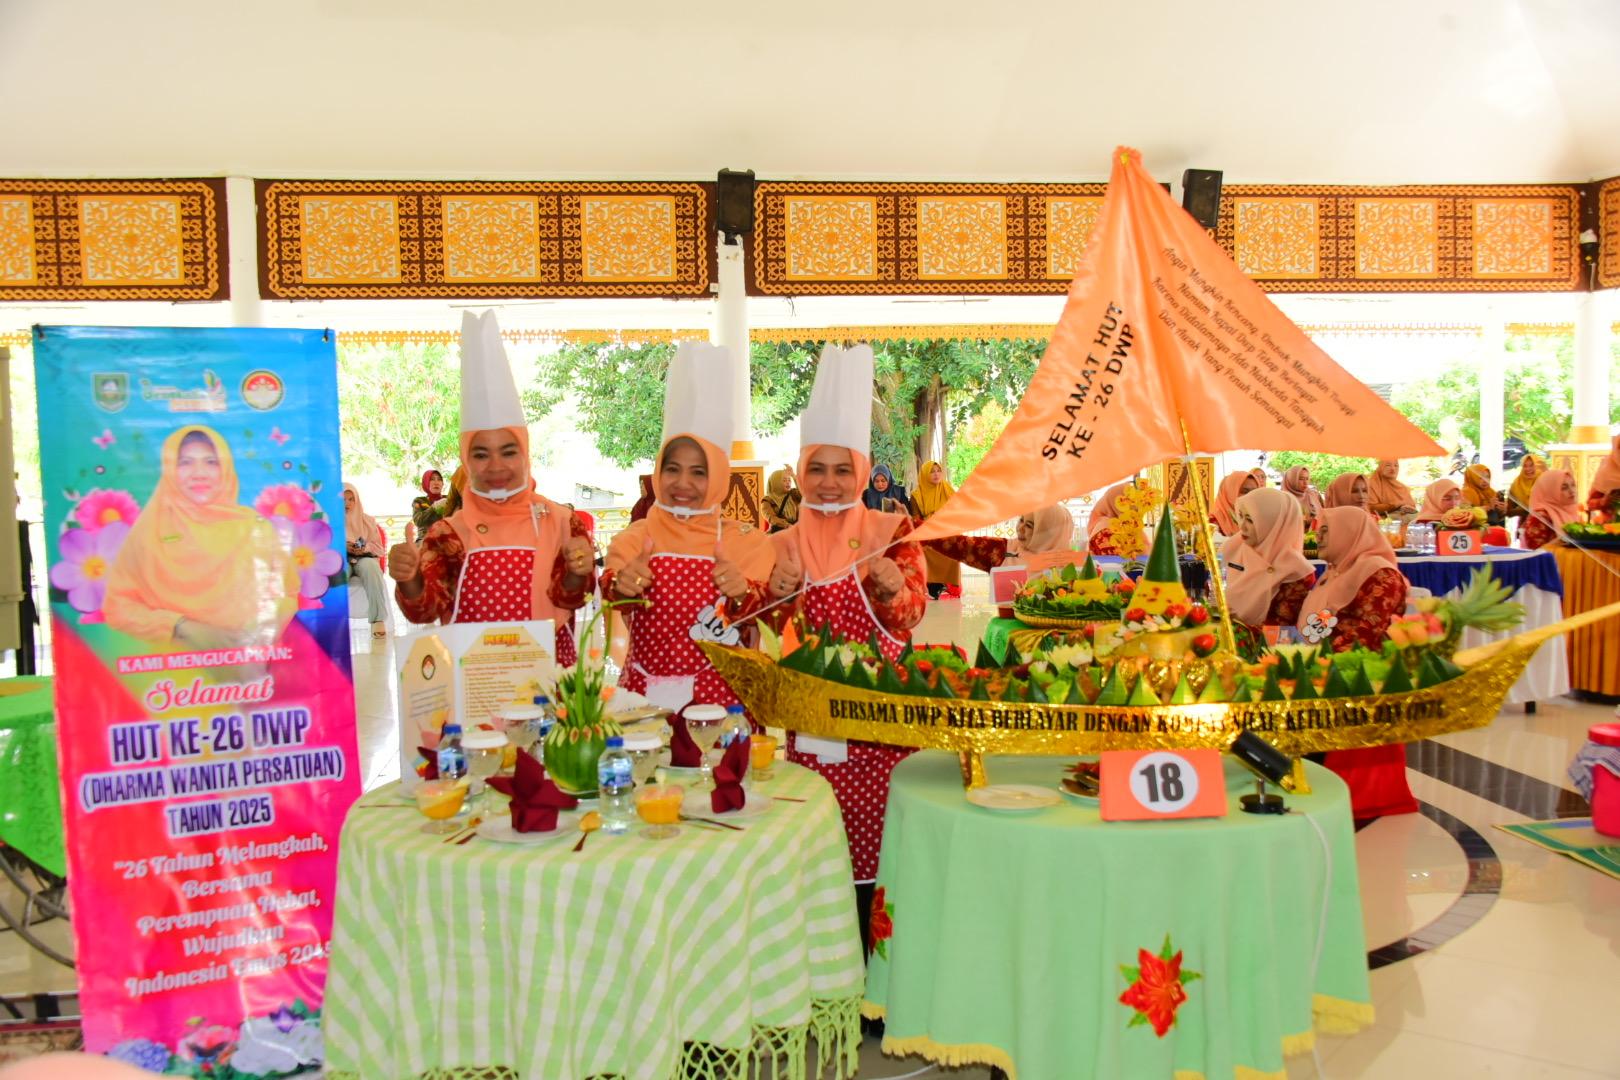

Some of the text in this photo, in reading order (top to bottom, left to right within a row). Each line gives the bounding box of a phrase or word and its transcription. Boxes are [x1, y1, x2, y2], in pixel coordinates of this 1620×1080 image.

[1152, 277, 1180, 309] Karena
[1179, 306, 1230, 354] Didalamnya
[1162, 248, 1187, 271] Angin
[1189, 267, 1224, 302] Mungkin
[1292, 360, 1329, 392] Mungkin
[1210, 310, 1238, 335] Kapal
[1159, 309, 1176, 329] Dan
[1202, 348, 1225, 373] Yang
[1223, 367, 1252, 394] Penuh
[1042, 301, 1123, 460] SELAMAT HUT
[1066, 426, 1095, 459] KE
[1094, 381, 1114, 408] 26
[1105, 324, 1134, 375] DWP
[1451, 535, 1468, 549] 25
[119, 647, 292, 672] KAMI MENGUCAPKAN:
[146, 676, 274, 711] Selamat
[829, 698, 898, 723] BERSAMA
[903, 704, 942, 726] DWP
[947, 706, 986, 728] KITA
[992, 708, 1078, 731] BERLAYAR
[1084, 712, 1150, 732] DENGAN
[111, 709, 310, 763] HUT KE-26 DWP
[83, 750, 342, 809] (DHARMA WANITA PERSATUAN)
[1139, 762, 1184, 802] 18
[168, 797, 271, 835] TAHUN 2025
[150, 851, 214, 876] Tahun
[216, 833, 328, 865] Melangkah,
[182, 871, 272, 899] Bersama
[136, 902, 255, 935] Perempuan
[125, 962, 227, 998] Indonesia
